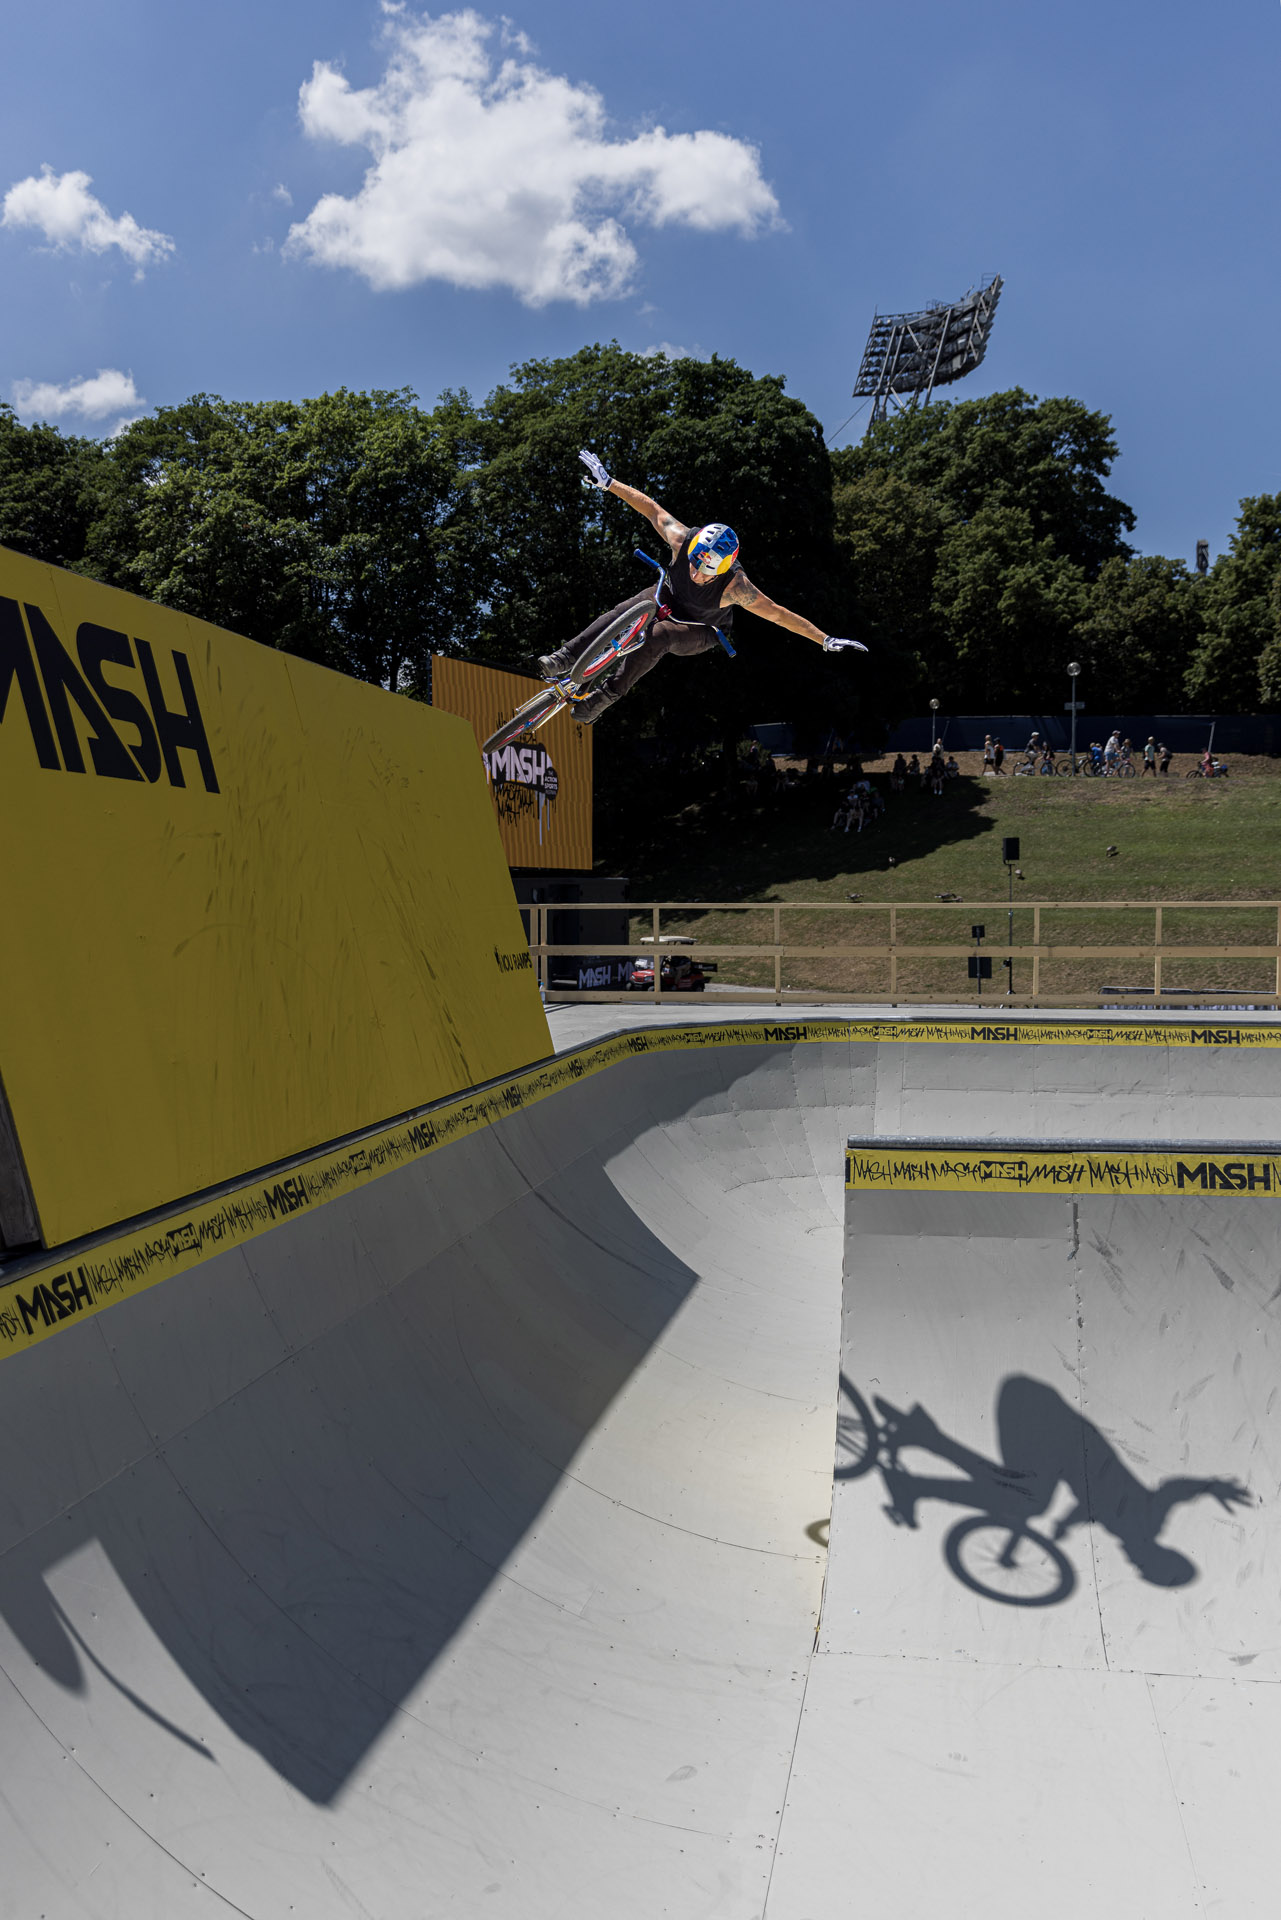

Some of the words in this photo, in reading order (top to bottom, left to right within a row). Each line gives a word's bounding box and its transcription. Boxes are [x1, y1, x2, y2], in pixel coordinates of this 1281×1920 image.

[491, 745, 546, 786] MASH
[578, 965, 611, 989] MASH
[15, 1266, 93, 1335] MASH
[263, 1175, 309, 1219] MASH
[407, 1120, 438, 1153] MASH
[502, 1084, 524, 1110] MASH
[627, 1036, 648, 1053] MASH
[764, 1026, 808, 1041] MASH
[971, 1026, 1018, 1041] MASH
[1191, 1029, 1240, 1044] MASH
[980, 1162, 1028, 1180] MASH
[1027, 1163, 1087, 1184] MASH
[1176, 1161, 1271, 1190] MASH
